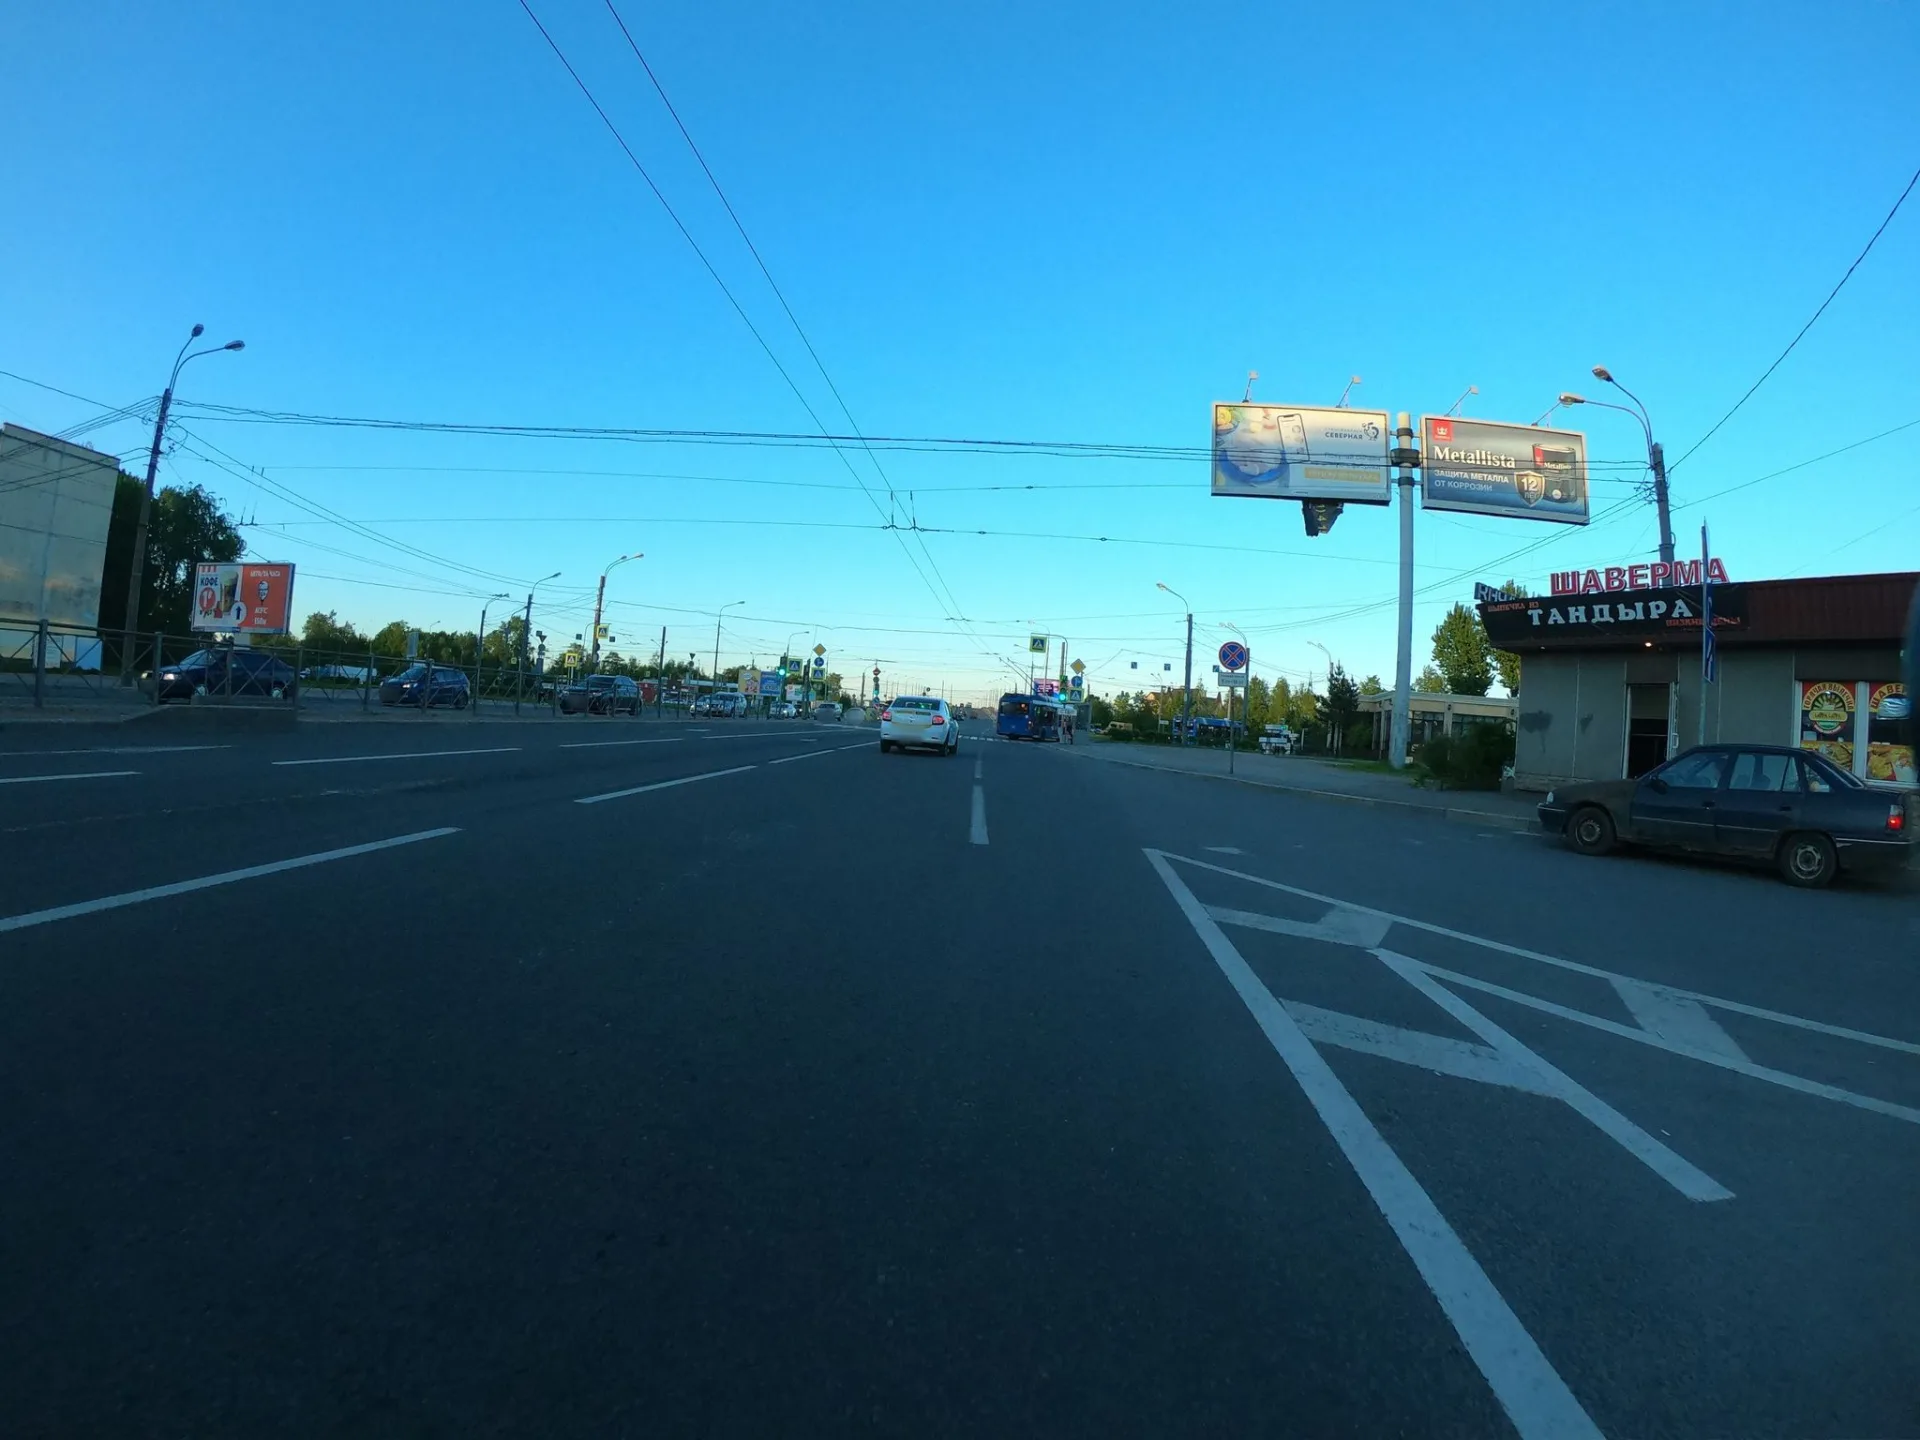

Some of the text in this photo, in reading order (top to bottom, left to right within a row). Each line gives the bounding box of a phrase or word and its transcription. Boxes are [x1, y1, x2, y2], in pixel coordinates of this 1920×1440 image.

[1325, 432, 1363, 440] СЕВЕРНАЯ
[1433, 445, 1515, 468] Metallista
[1434, 469, 1509, 484] ЗАЩИТА МЕТАЛЛА
[1434, 480, 1493, 492] ОТ КОРРОЗИИ
[1521, 477, 1538, 492] 12
[200, 577, 218, 586] КОФЕ
[1550, 557, 1730, 596] ШАВЕРМА
[1527, 597, 1694, 626] ТАНДЫРА
